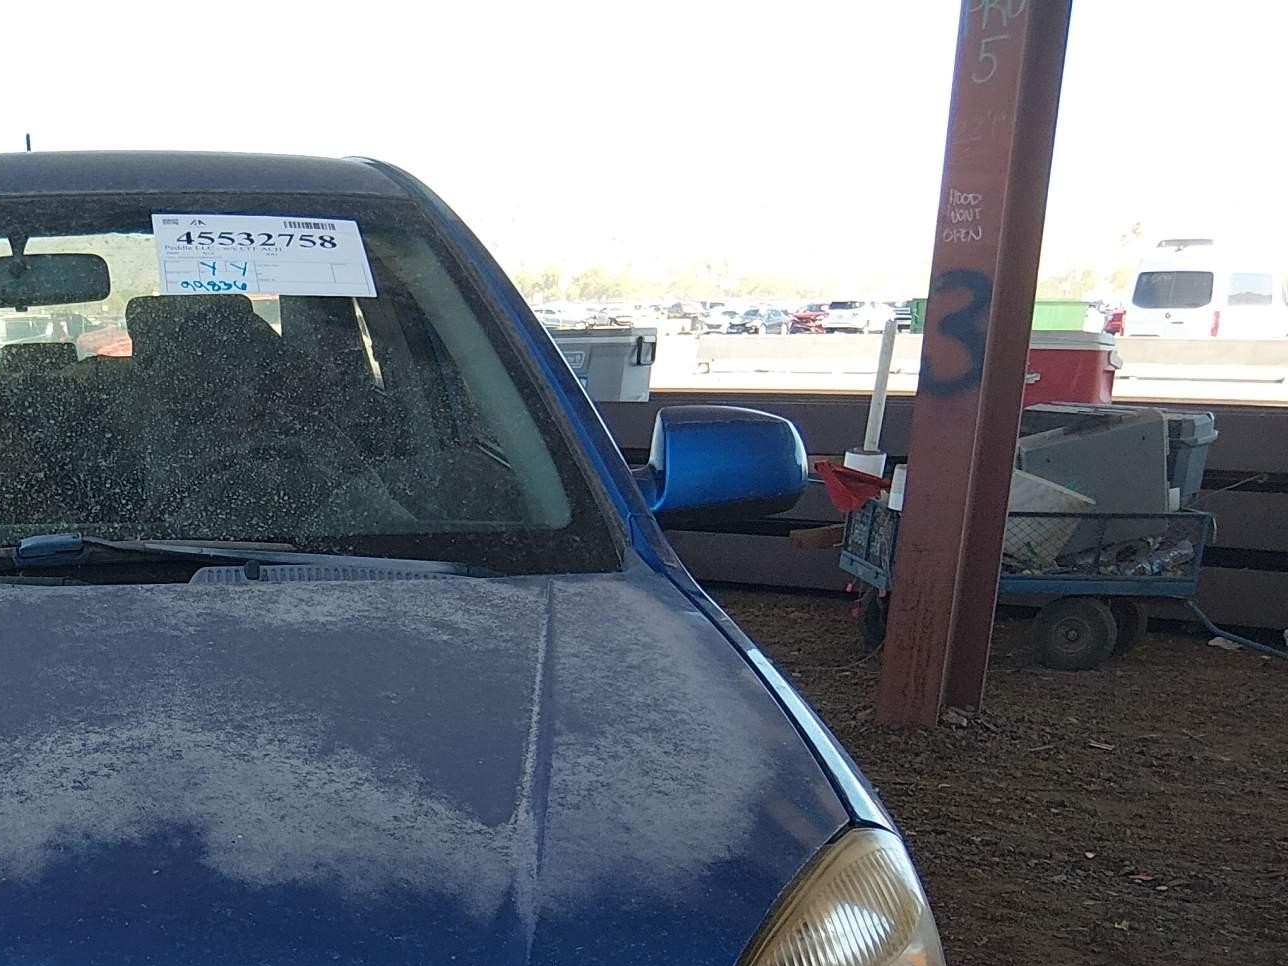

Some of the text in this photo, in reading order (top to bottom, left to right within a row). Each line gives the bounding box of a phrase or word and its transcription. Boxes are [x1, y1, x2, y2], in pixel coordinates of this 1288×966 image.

[972, 34, 1009, 84] 5
[950, 189, 982, 206] HOOD
[177, 231, 338, 249] 45532758
[943, 226, 982, 243] OPEN
[920, 268, 993, 396] 3
